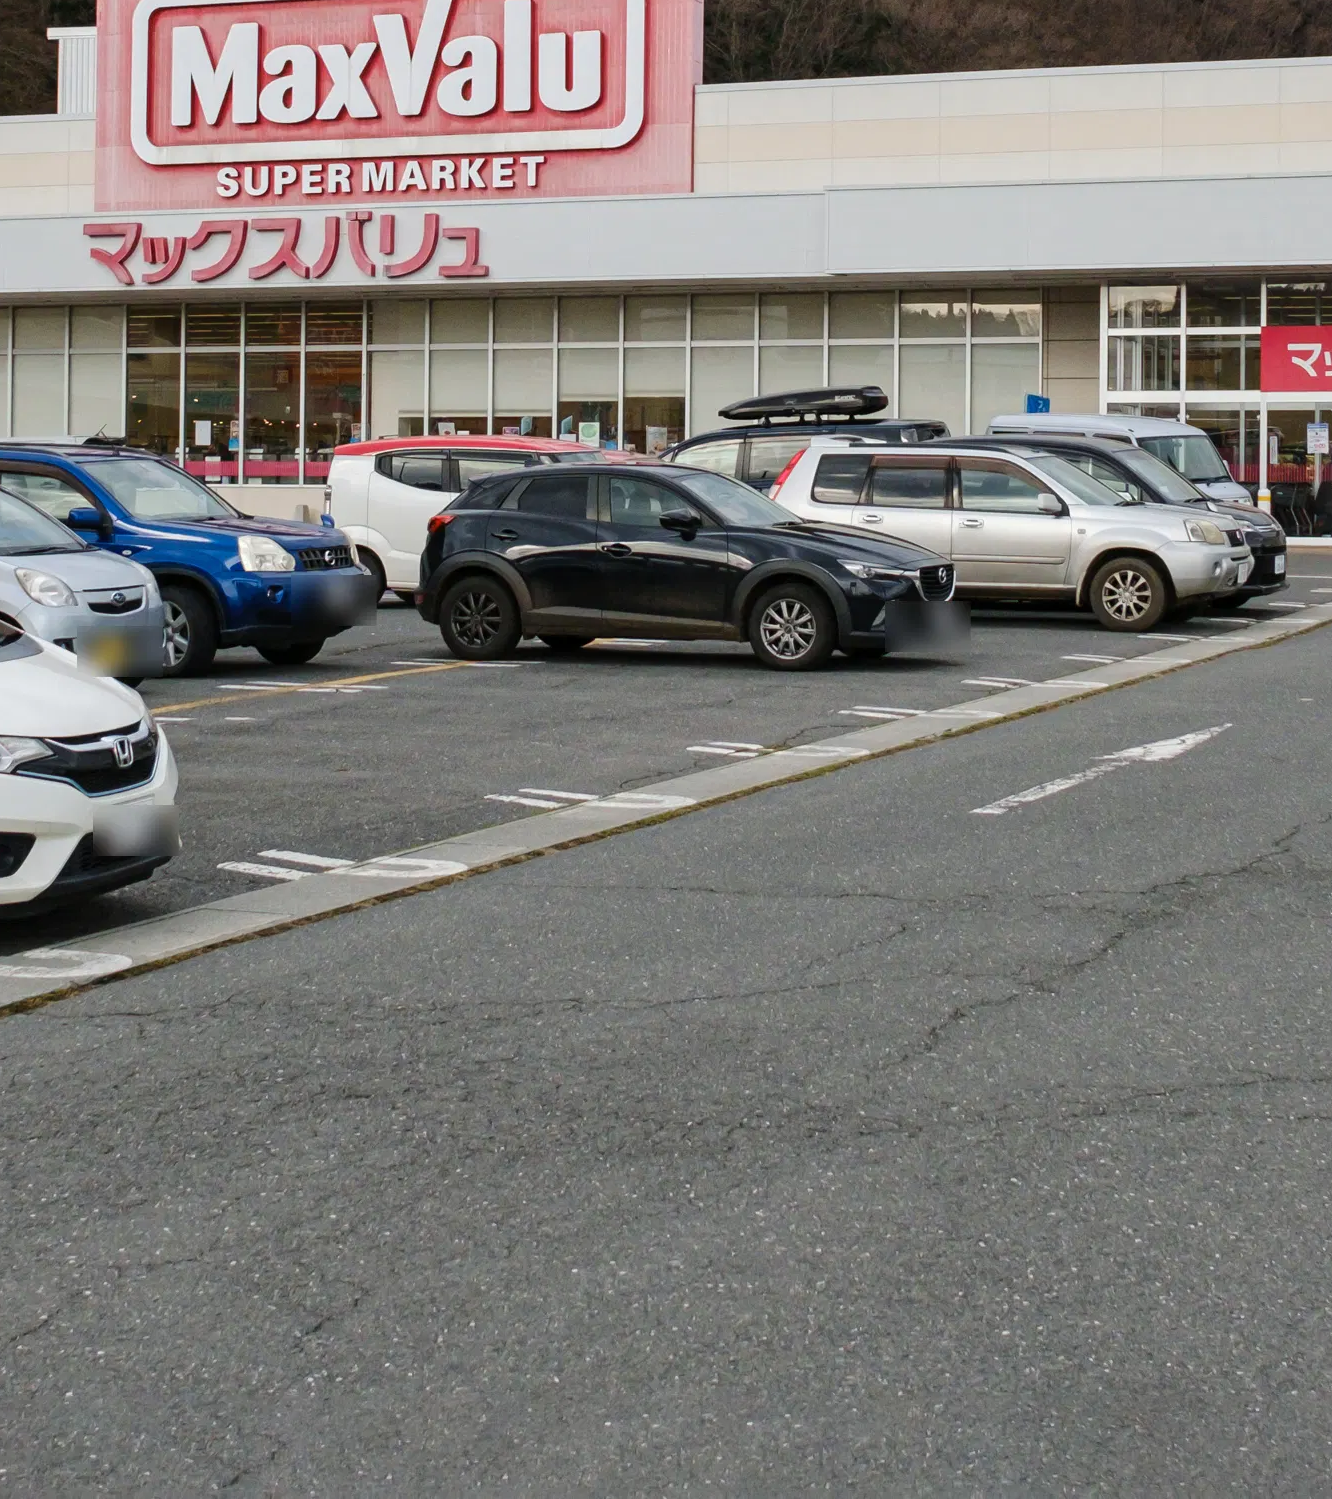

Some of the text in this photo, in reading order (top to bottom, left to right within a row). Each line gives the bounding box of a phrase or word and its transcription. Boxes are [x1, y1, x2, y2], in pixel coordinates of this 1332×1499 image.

[215, 154, 547, 199] SUPER MARKET
[82, 210, 490, 286] マックスバリュ
